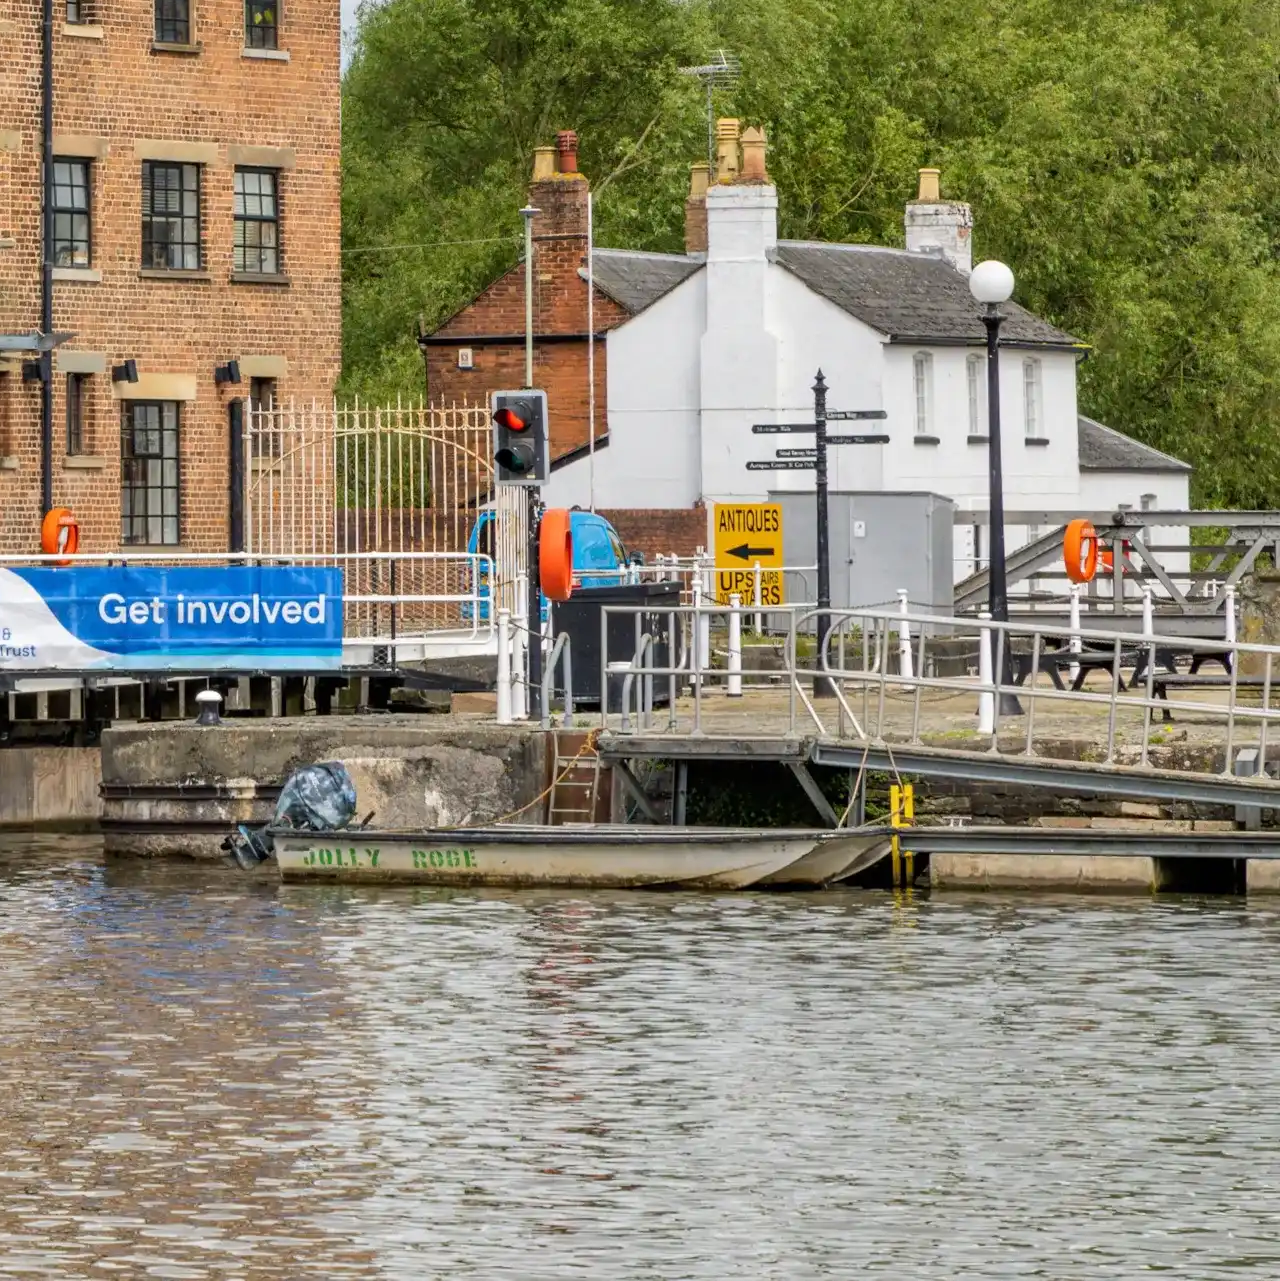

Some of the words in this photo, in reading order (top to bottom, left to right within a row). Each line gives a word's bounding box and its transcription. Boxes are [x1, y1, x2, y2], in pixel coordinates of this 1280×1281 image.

[719, 509, 779, 533] ANTIQUES
[720, 572, 779, 591] UPSAIRS
[98, 593, 164, 625] Get
[177, 593, 325, 625] involved
[2, 628, 12, 641] &
[303, 848, 380, 867] JOLLY
